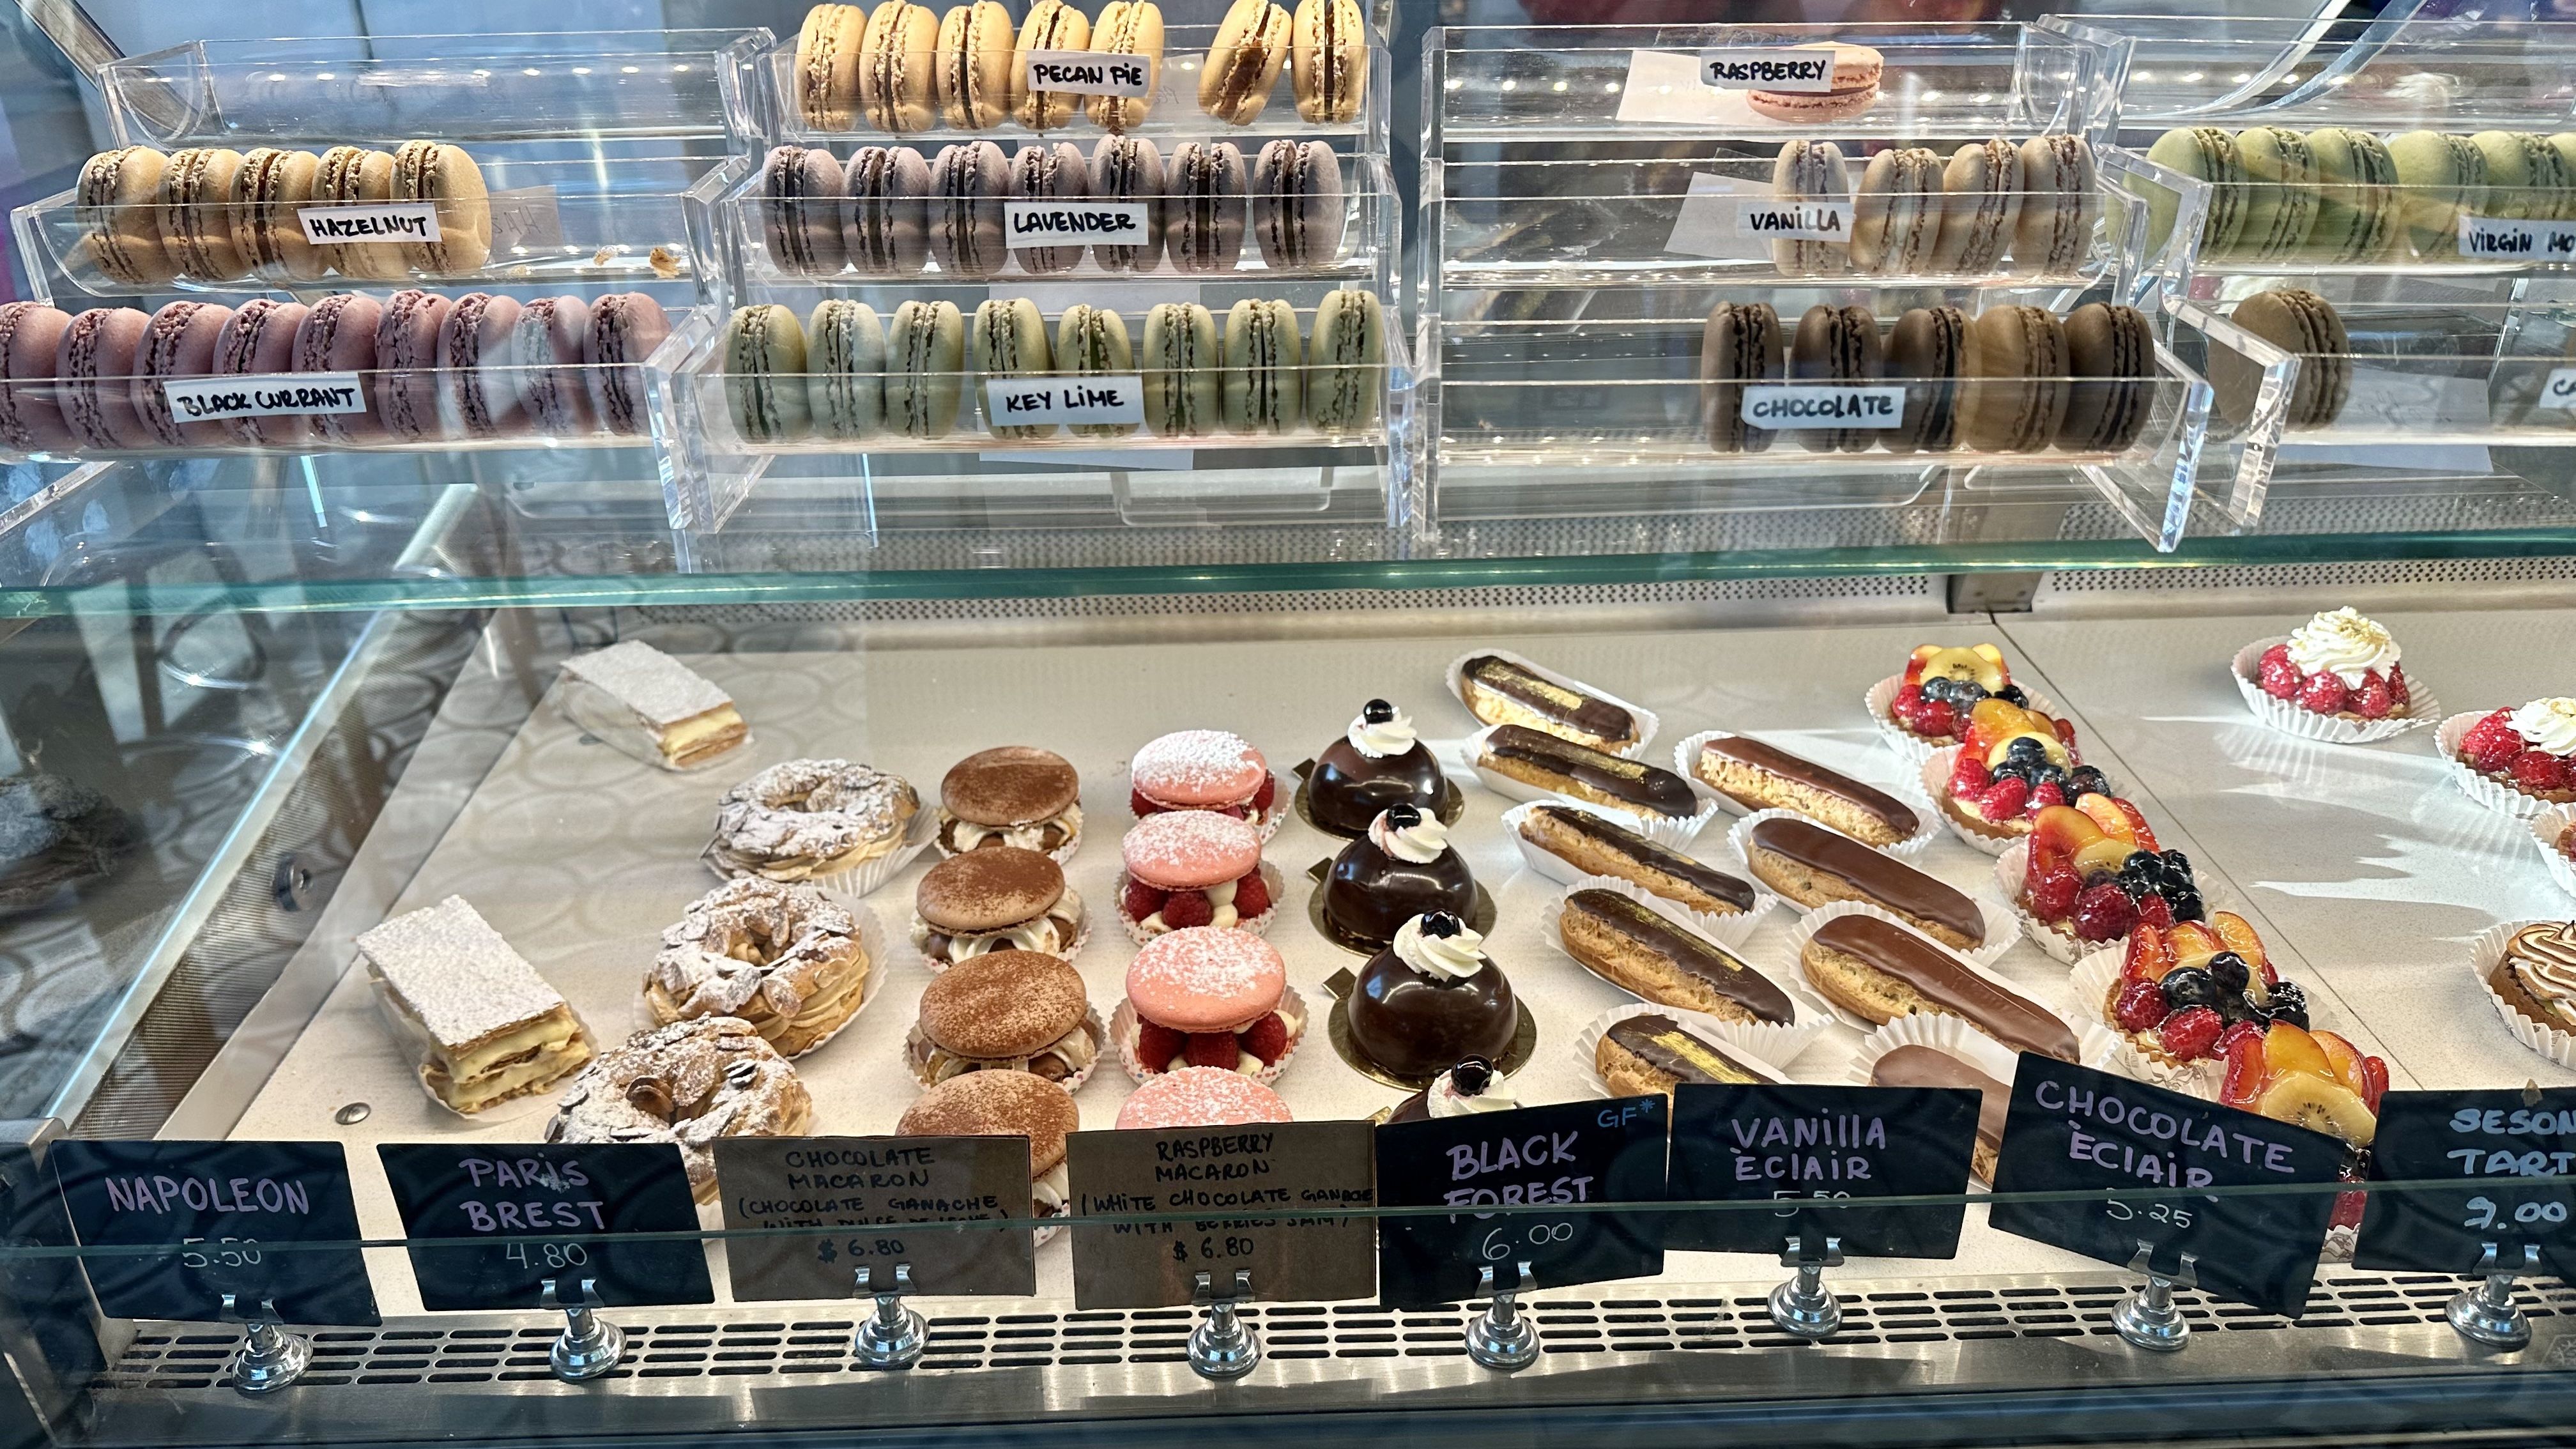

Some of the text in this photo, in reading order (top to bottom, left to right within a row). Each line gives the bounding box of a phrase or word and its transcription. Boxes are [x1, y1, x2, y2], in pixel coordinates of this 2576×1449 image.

[1033, 63, 1142, 86] PECAN PiE
[1710, 59, 1826, 80] RASPBERRY
[309, 215, 427, 237] HAZELNUT
[1014, 211, 1136, 233] LAVENDER
[1750, 206, 1841, 231] VANiLLA
[2468, 227, 2533, 253] ViRGiN
[177, 387, 355, 417] BLACK CURRANT
[1006, 385, 1124, 413] KEY LiME
[1752, 394, 1894, 418] CHOCOLATE
[1731, 1108, 1885, 1149] VANillA
[2035, 1080, 2295, 1173] CHOCOLATE
[2449, 1108, 2576, 1135] SESON
[785, 1147, 935, 1169] CHOCOLATE
[1155, 1132, 1274, 1162] RASPBERRY
[1446, 1130, 1578, 1181] BLACK
[1155, 1158, 1270, 1183] MACARON
[2446, 1149, 2576, 1177] TART
[788, 1169, 929, 1190] MACARON
[105, 1176, 309, 1215] NAPOLEON
[888, 1195, 998, 1213] GANACHE
[1169, 1188, 1291, 1207] CHOCOLATE
[1443, 1176, 1594, 1224] FOREST
[2106, 1187, 2192, 1229] 5.25
[459, 1200, 605, 1232] BREST
[2464, 1196, 2567, 1230] 9.00
[182, 1238, 262, 1268] 5.50
[847, 1239, 905, 1257] 6.80
[1200, 1236, 1255, 1259] 6.80
[1482, 1222, 1574, 1261] 6.00
[506, 1243, 588, 1269] 4.80
